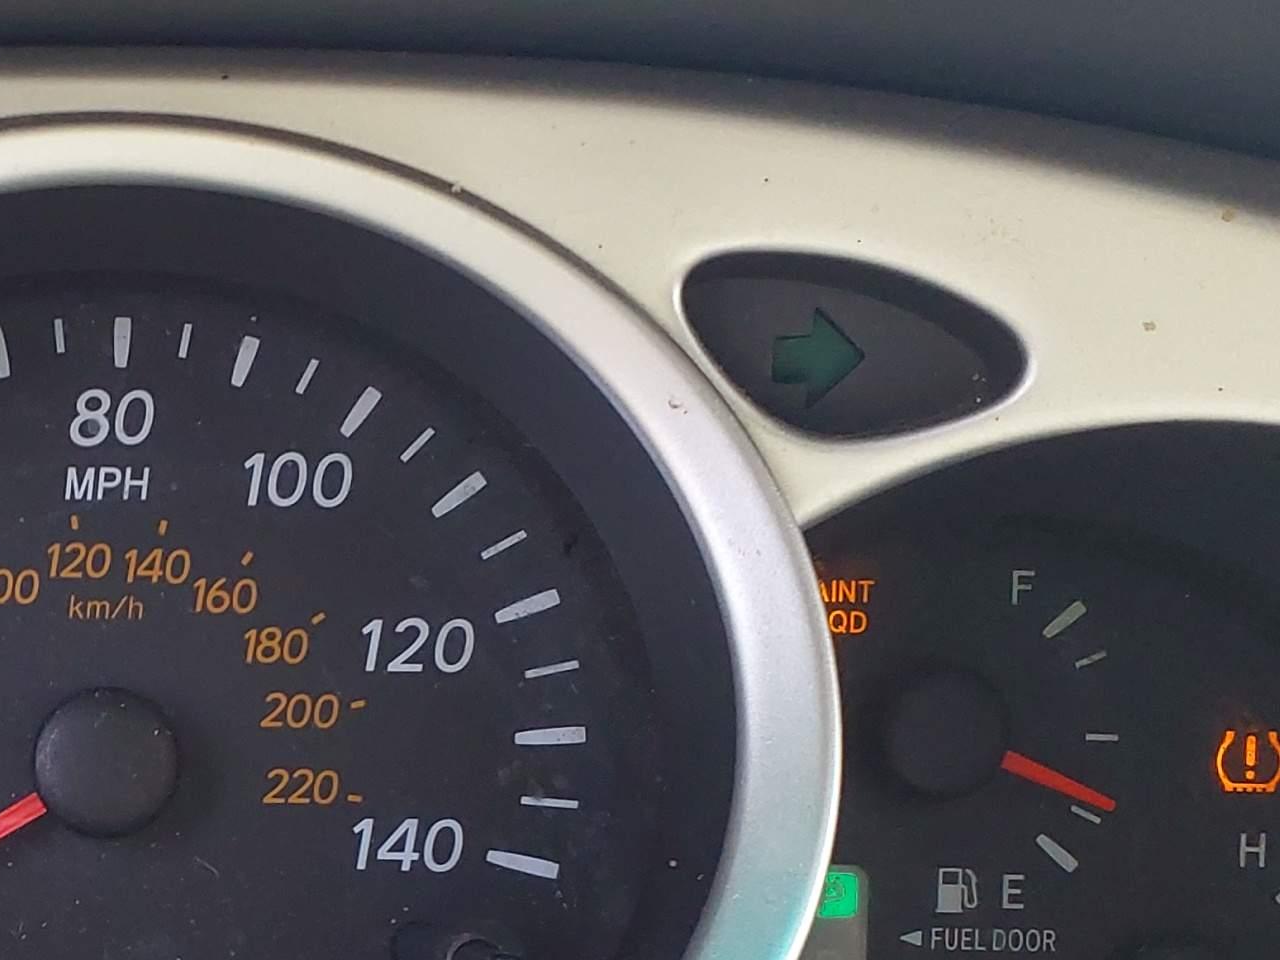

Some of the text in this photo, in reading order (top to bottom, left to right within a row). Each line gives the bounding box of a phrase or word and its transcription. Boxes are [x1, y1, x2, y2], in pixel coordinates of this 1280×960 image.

[70, 389, 153, 446] 80
[65, 467, 149, 500] MPH
[245, 452, 352, 507] 100
[48, 543, 111, 578] 120
[125, 549, 190, 584] 140
[194, 578, 257, 613] 160
[1012, 571, 1035, 604] F
[70, 595, 143, 619] km/h
[245, 627, 307, 664] 180
[362, 618, 474, 672] 120
[261, 693, 339, 728] 200
[263, 769, 338, 804] 220
[353, 819, 463, 872] 140
[1240, 833, 1265, 867] H
[1003, 875, 1024, 908] E
[931, 928, 1055, 951] FUEL DOOR
